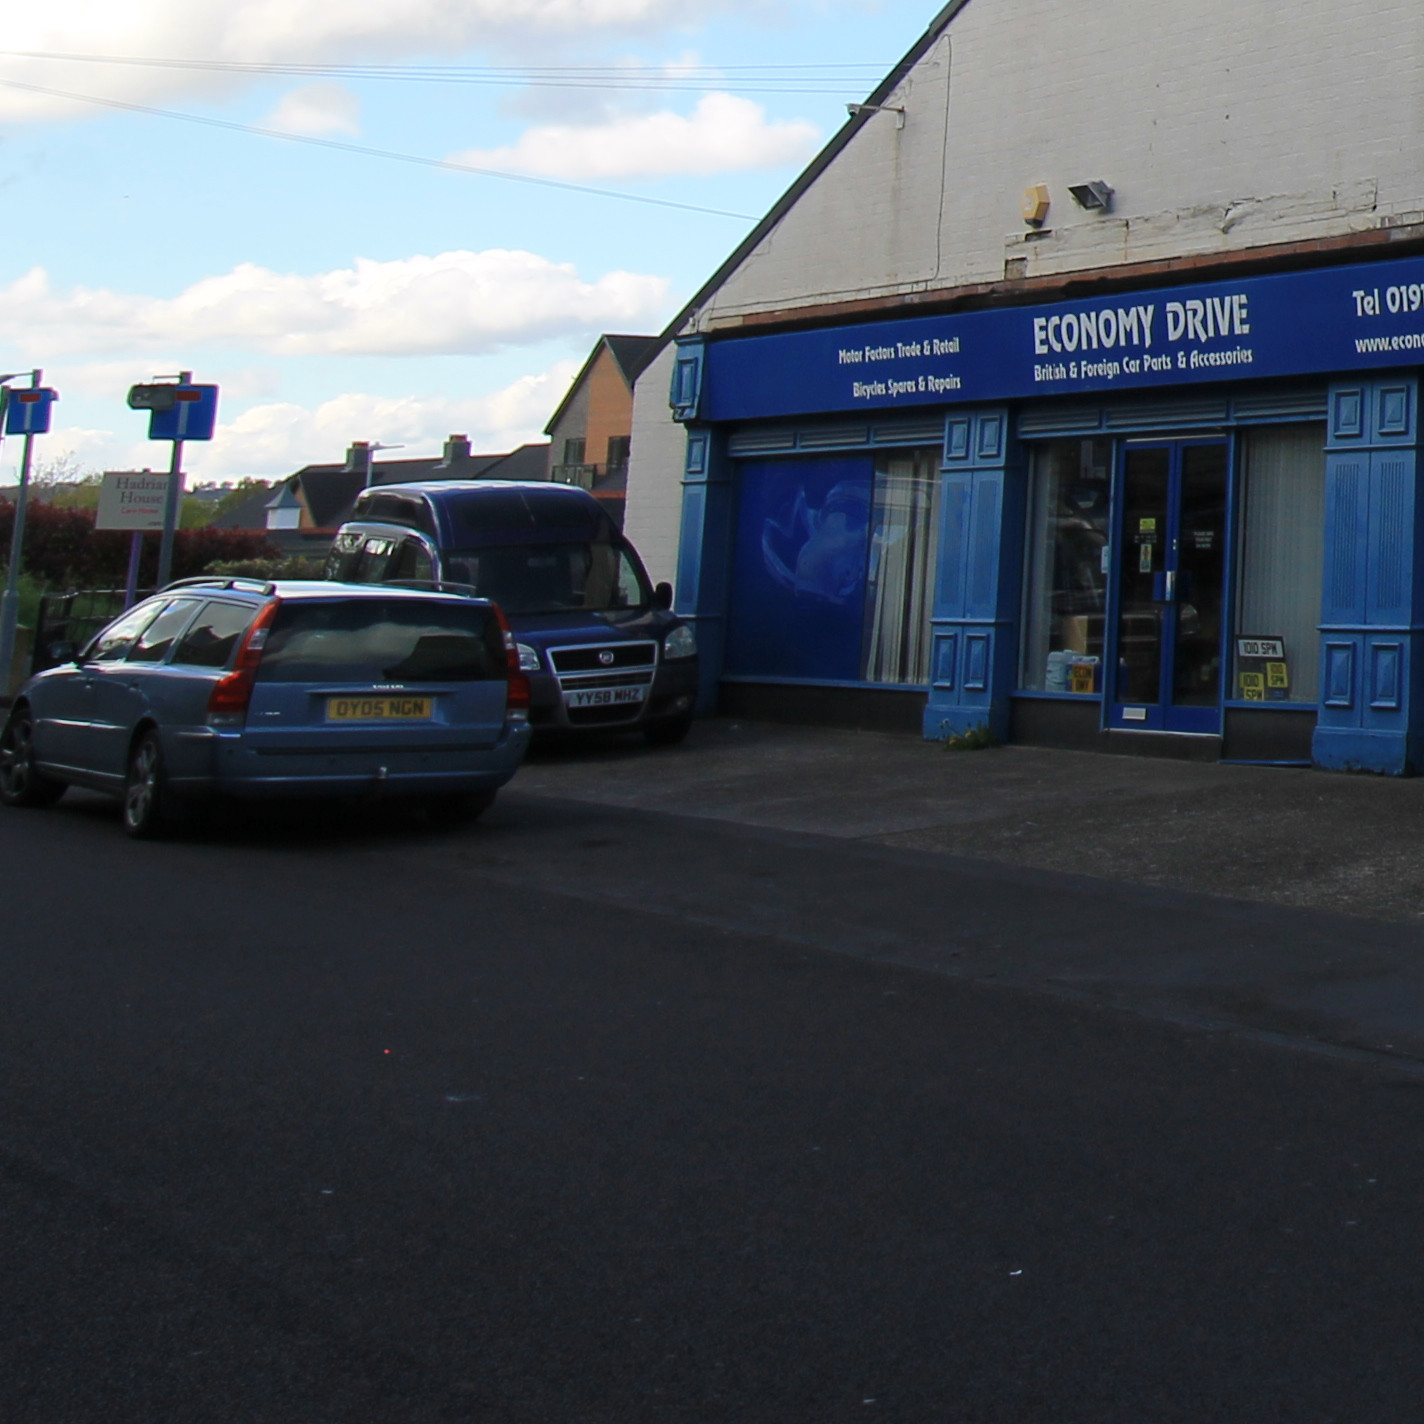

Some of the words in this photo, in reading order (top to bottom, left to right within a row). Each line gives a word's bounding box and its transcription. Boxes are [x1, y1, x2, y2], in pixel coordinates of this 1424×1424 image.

[1352, 288, 1380, 316] Tel
[1034, 304, 1154, 355] ECONOMY
[1166, 294, 1250, 343] DRIVE
[838, 349, 862, 364] Motor
[865, 345, 894, 362] Factors
[897, 341, 921, 357] Trade
[923, 340, 930, 355] &
[933, 337, 959, 355] Retail
[1034, 362, 1066, 381] British
[1069, 361, 1077, 378] &
[1081, 359, 1120, 380] Foreign
[1123, 357, 1140, 373] Car
[1143, 354, 1171, 372] Parts
[1178, 351, 1186, 368] &
[1190, 346, 1253, 369] Accessories
[853, 380, 885, 399] Bicycles
[888, 379, 915, 397] Spares
[918, 376, 925, 391] &
[928, 374, 961, 393] Repairs
[120, 491, 164, 503] House
[388, 699, 424, 716] NGN
